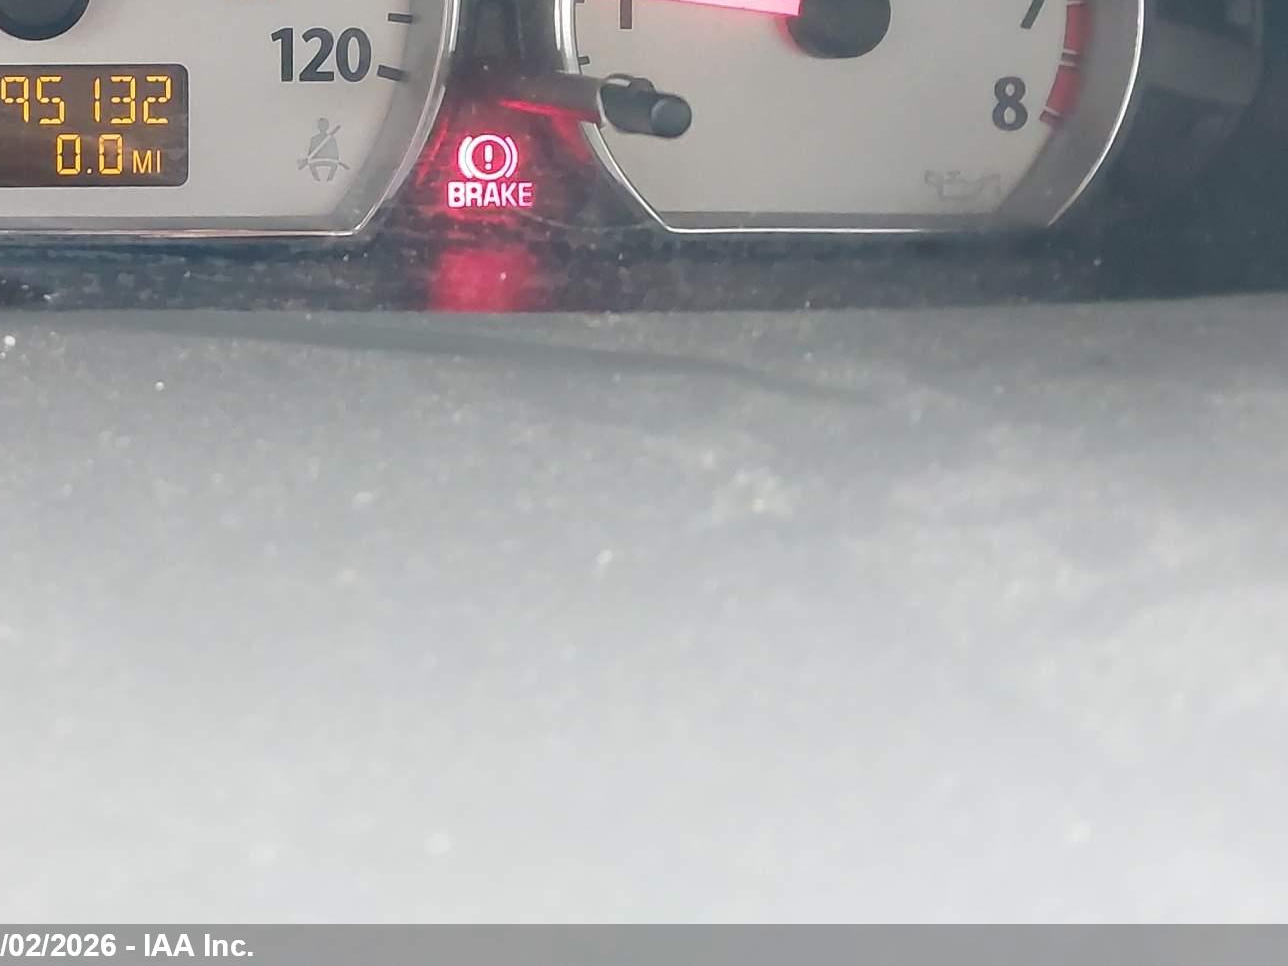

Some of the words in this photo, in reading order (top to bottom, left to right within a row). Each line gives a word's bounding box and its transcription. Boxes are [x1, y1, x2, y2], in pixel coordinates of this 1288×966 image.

[270, 27, 372, 84] 120
[0, 76, 173, 126] 95132
[992, 75, 1028, 132] 8
[56, 133, 123, 177] 0.0
[133, 150, 162, 174] MI
[447, 181, 534, 208] BRAKE
